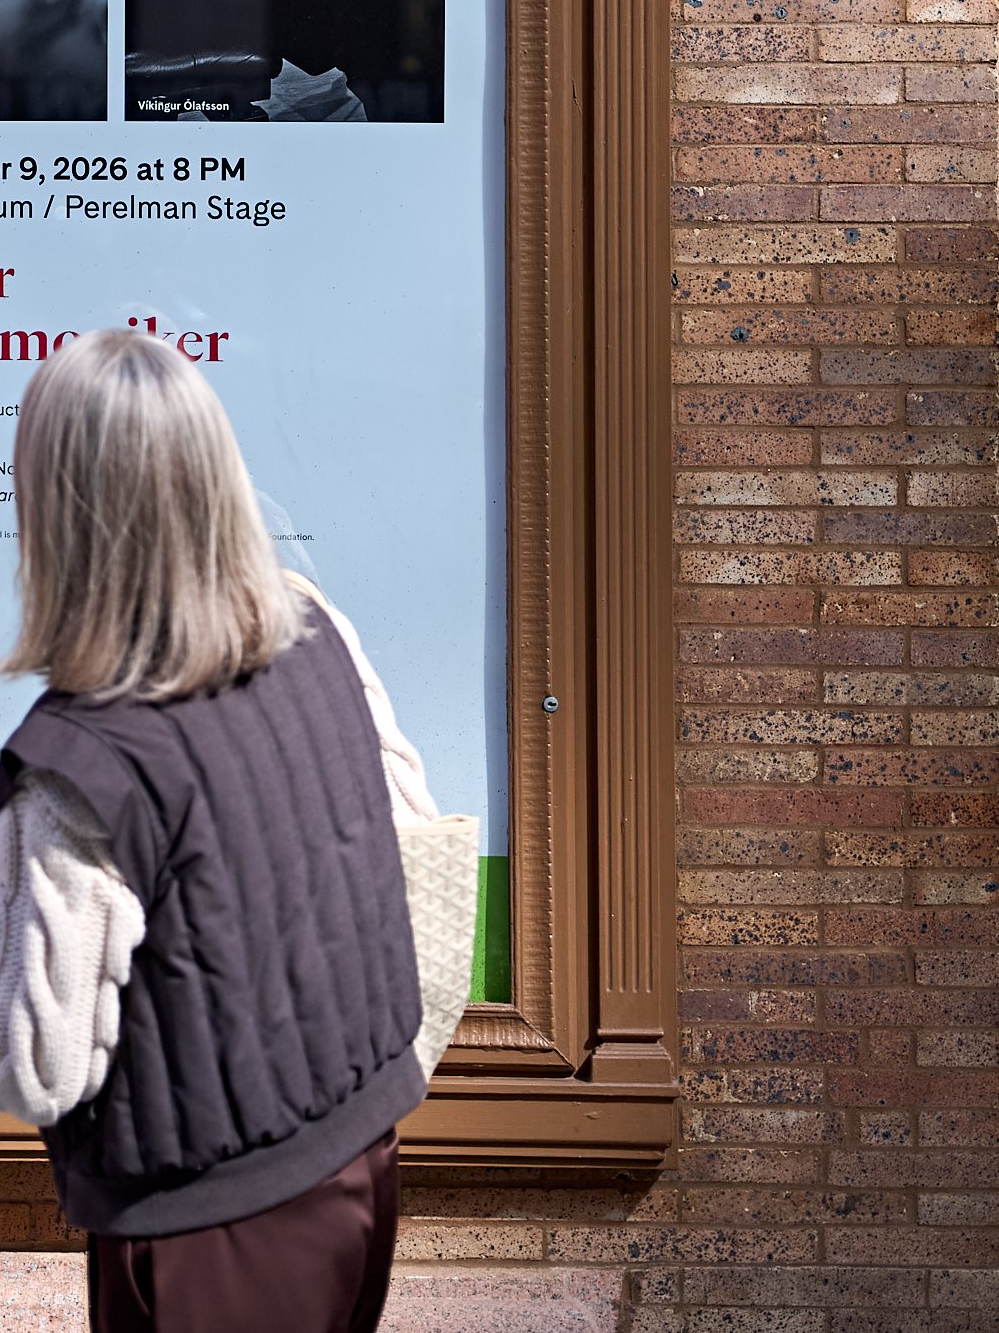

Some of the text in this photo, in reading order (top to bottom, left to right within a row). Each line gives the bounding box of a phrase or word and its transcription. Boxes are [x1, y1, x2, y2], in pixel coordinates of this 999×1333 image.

[137, 98, 230, 113] Víkingur Ólafsson
[19, 156, 45, 185] 9,
[53, 156, 128, 182] 2026
[137, 158, 165, 181] at
[173, 157, 190, 182] 8
[200, 157, 245, 182] PM
[43, 194, 55, 219] /
[66, 194, 197, 220] Perelman
[207, 195, 287, 227] Stage
[5, 531, 11, 539] is
